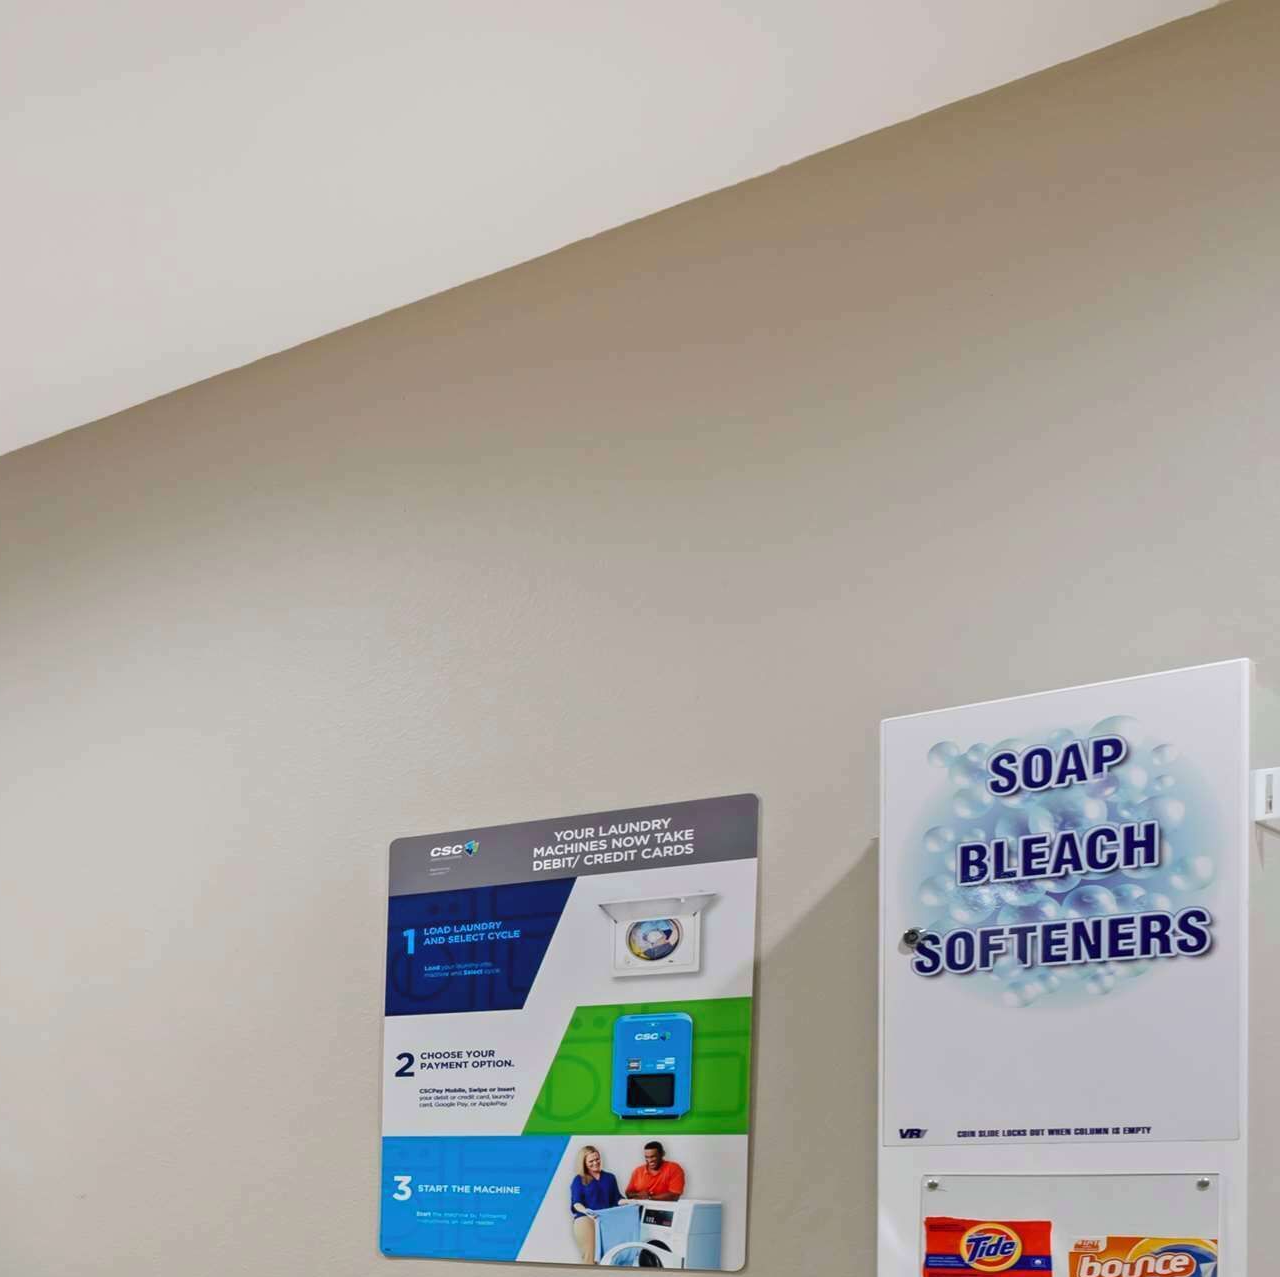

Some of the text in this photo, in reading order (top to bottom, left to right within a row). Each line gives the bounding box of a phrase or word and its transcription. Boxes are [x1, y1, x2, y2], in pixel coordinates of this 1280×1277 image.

[988, 736, 1126, 795] SOAP
[554, 818, 672, 842] YOUR LAUNDRY
[430, 844, 463, 857] CSC
[533, 829, 694, 858] MACHINES NOW TAKE
[958, 822, 1158, 885] BLEACH
[532, 843, 694, 871] DEBIT/ CREDIT CARDS
[403, 928, 415, 954] 1
[423, 921, 502, 936] LOAD LAUNDRY
[423, 929, 521, 946] AND SELECT CYCLE
[914, 908, 1208, 975] SOFTENERS
[395, 1052, 415, 1078] 2
[420, 1049, 495, 1060] CHOOSE YOUR
[420, 1059, 514, 1070] PAYMENT OPTION.
[978, 1129, 1000, 1137] SLIDE
[1002, 1128, 1028, 1137] LOCKS
[1029, 1128, 1045, 1136] OUT
[1047, 1128, 1071, 1136] WHEN
[1073, 1127, 1109, 1136] COLUMN
[1111, 1127, 1120, 1135] IS
[1122, 1126, 1152, 1135] EMPTY
[393, 1175, 412, 1200] 3
[418, 1184, 521, 1194] START THE MACHINE
[965, 1235, 1017, 1264] Tide
